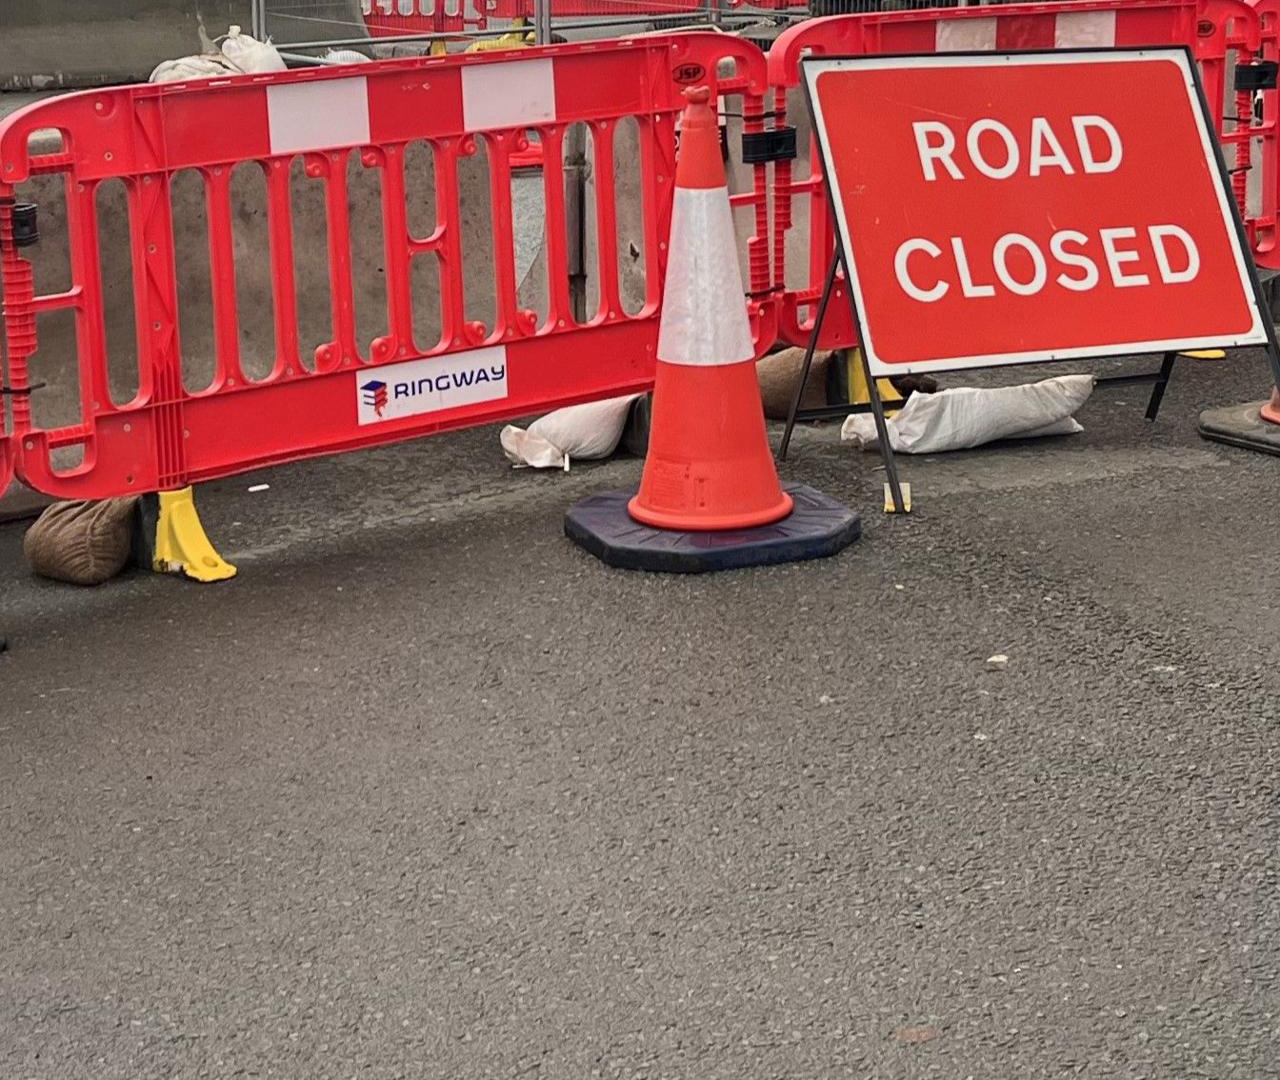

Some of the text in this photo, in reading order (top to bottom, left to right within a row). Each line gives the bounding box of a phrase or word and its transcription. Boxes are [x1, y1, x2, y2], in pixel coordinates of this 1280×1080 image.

[678, 66, 701, 79] JSP
[912, 115, 1123, 181] ROAD
[894, 224, 1201, 303] CLOSED
[394, 364, 505, 399] RINGWAY
